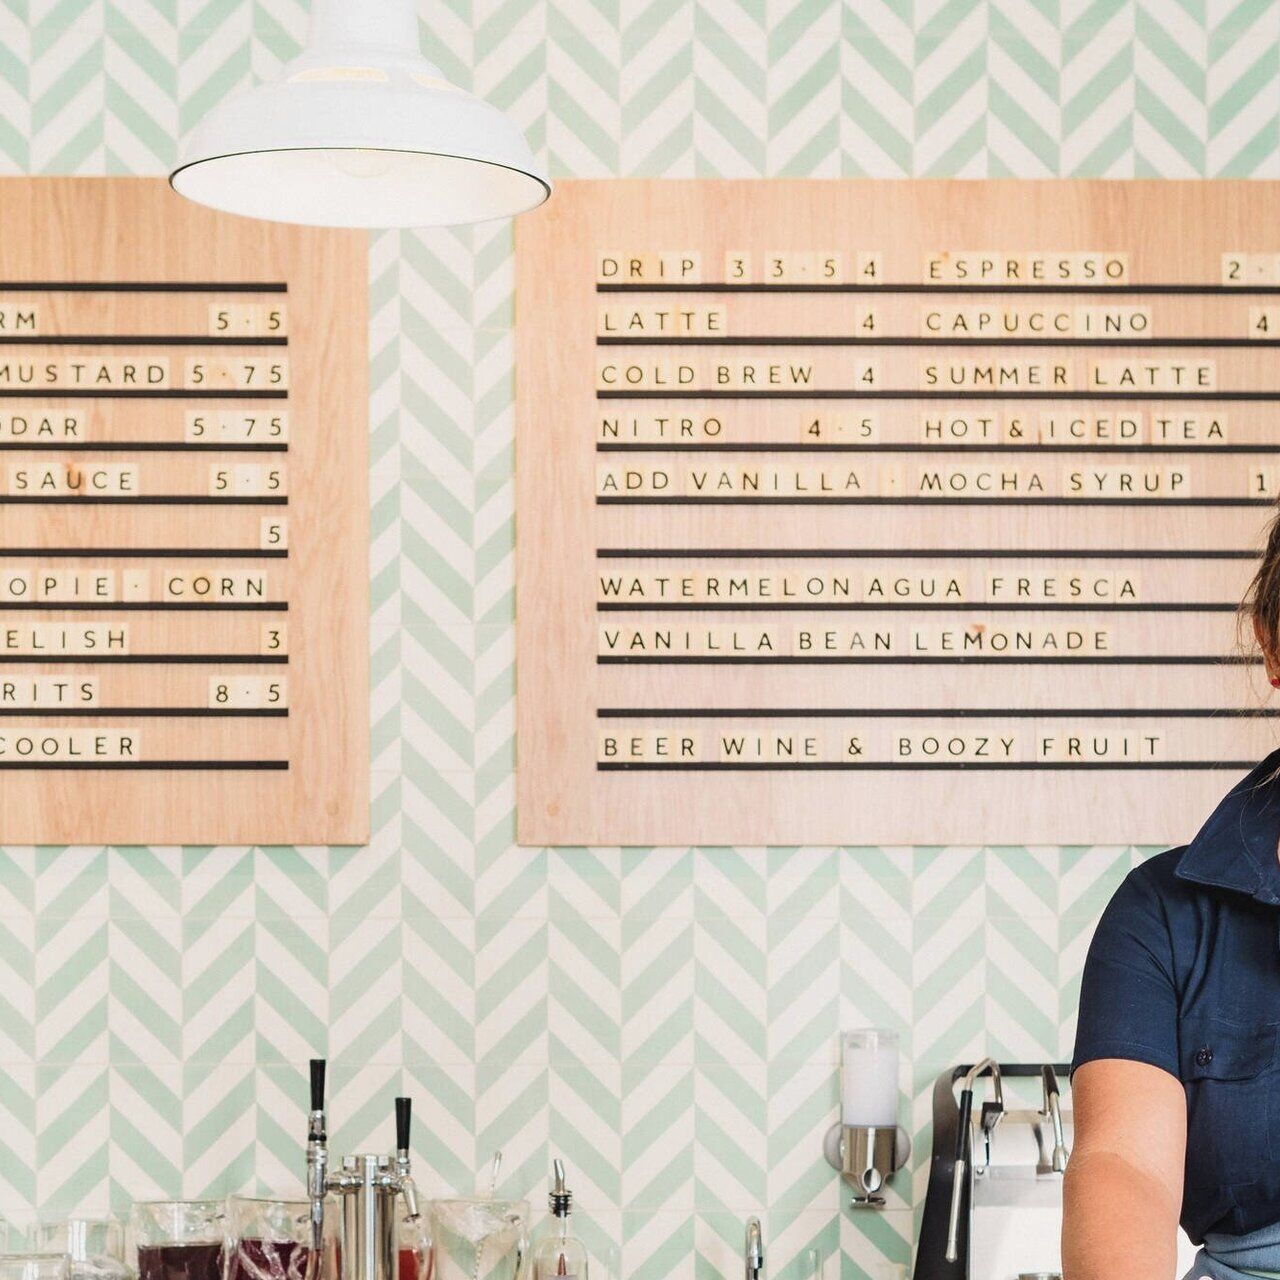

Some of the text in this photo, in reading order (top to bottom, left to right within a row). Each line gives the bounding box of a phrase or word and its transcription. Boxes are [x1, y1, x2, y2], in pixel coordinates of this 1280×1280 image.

[602, 258, 695, 277] DRIP
[733, 260, 745, 278] 3
[862, 260, 878, 278] 4
[929, 260, 1125, 279] ESPRESSO
[604, 312, 875, 331] LATTE 4
[926, 313, 1148, 333] CAPUCCINO
[601, 365, 874, 385] COLD BREW 4
[925, 365, 1068, 385] SUMMER
[1095, 366, 1208, 386] LATTE
[602, 418, 722, 438] NITRO
[925, 419, 992, 439] HOT
[1009, 419, 1023, 439] &
[1050, 419, 1137, 439] ICED
[1157, 419, 1224, 439] TEA
[15, 469, 131, 491] SAUCE
[602, 471, 1266, 493] ADD VANILLA MOCHA SYRUP 1
[268, 525, 281, 544] 5
[44, 577, 108, 596] PIE
[168, 576, 263, 597] CORN
[600, 577, 1137, 598] WATERMELON AGUA FRESCA
[268, 630, 281, 650] 3
[604, 630, 1109, 652] VANILLA BEAN LEMONADE
[604, 736, 1161, 757] BEER WINE & BOOZY FRUIT
